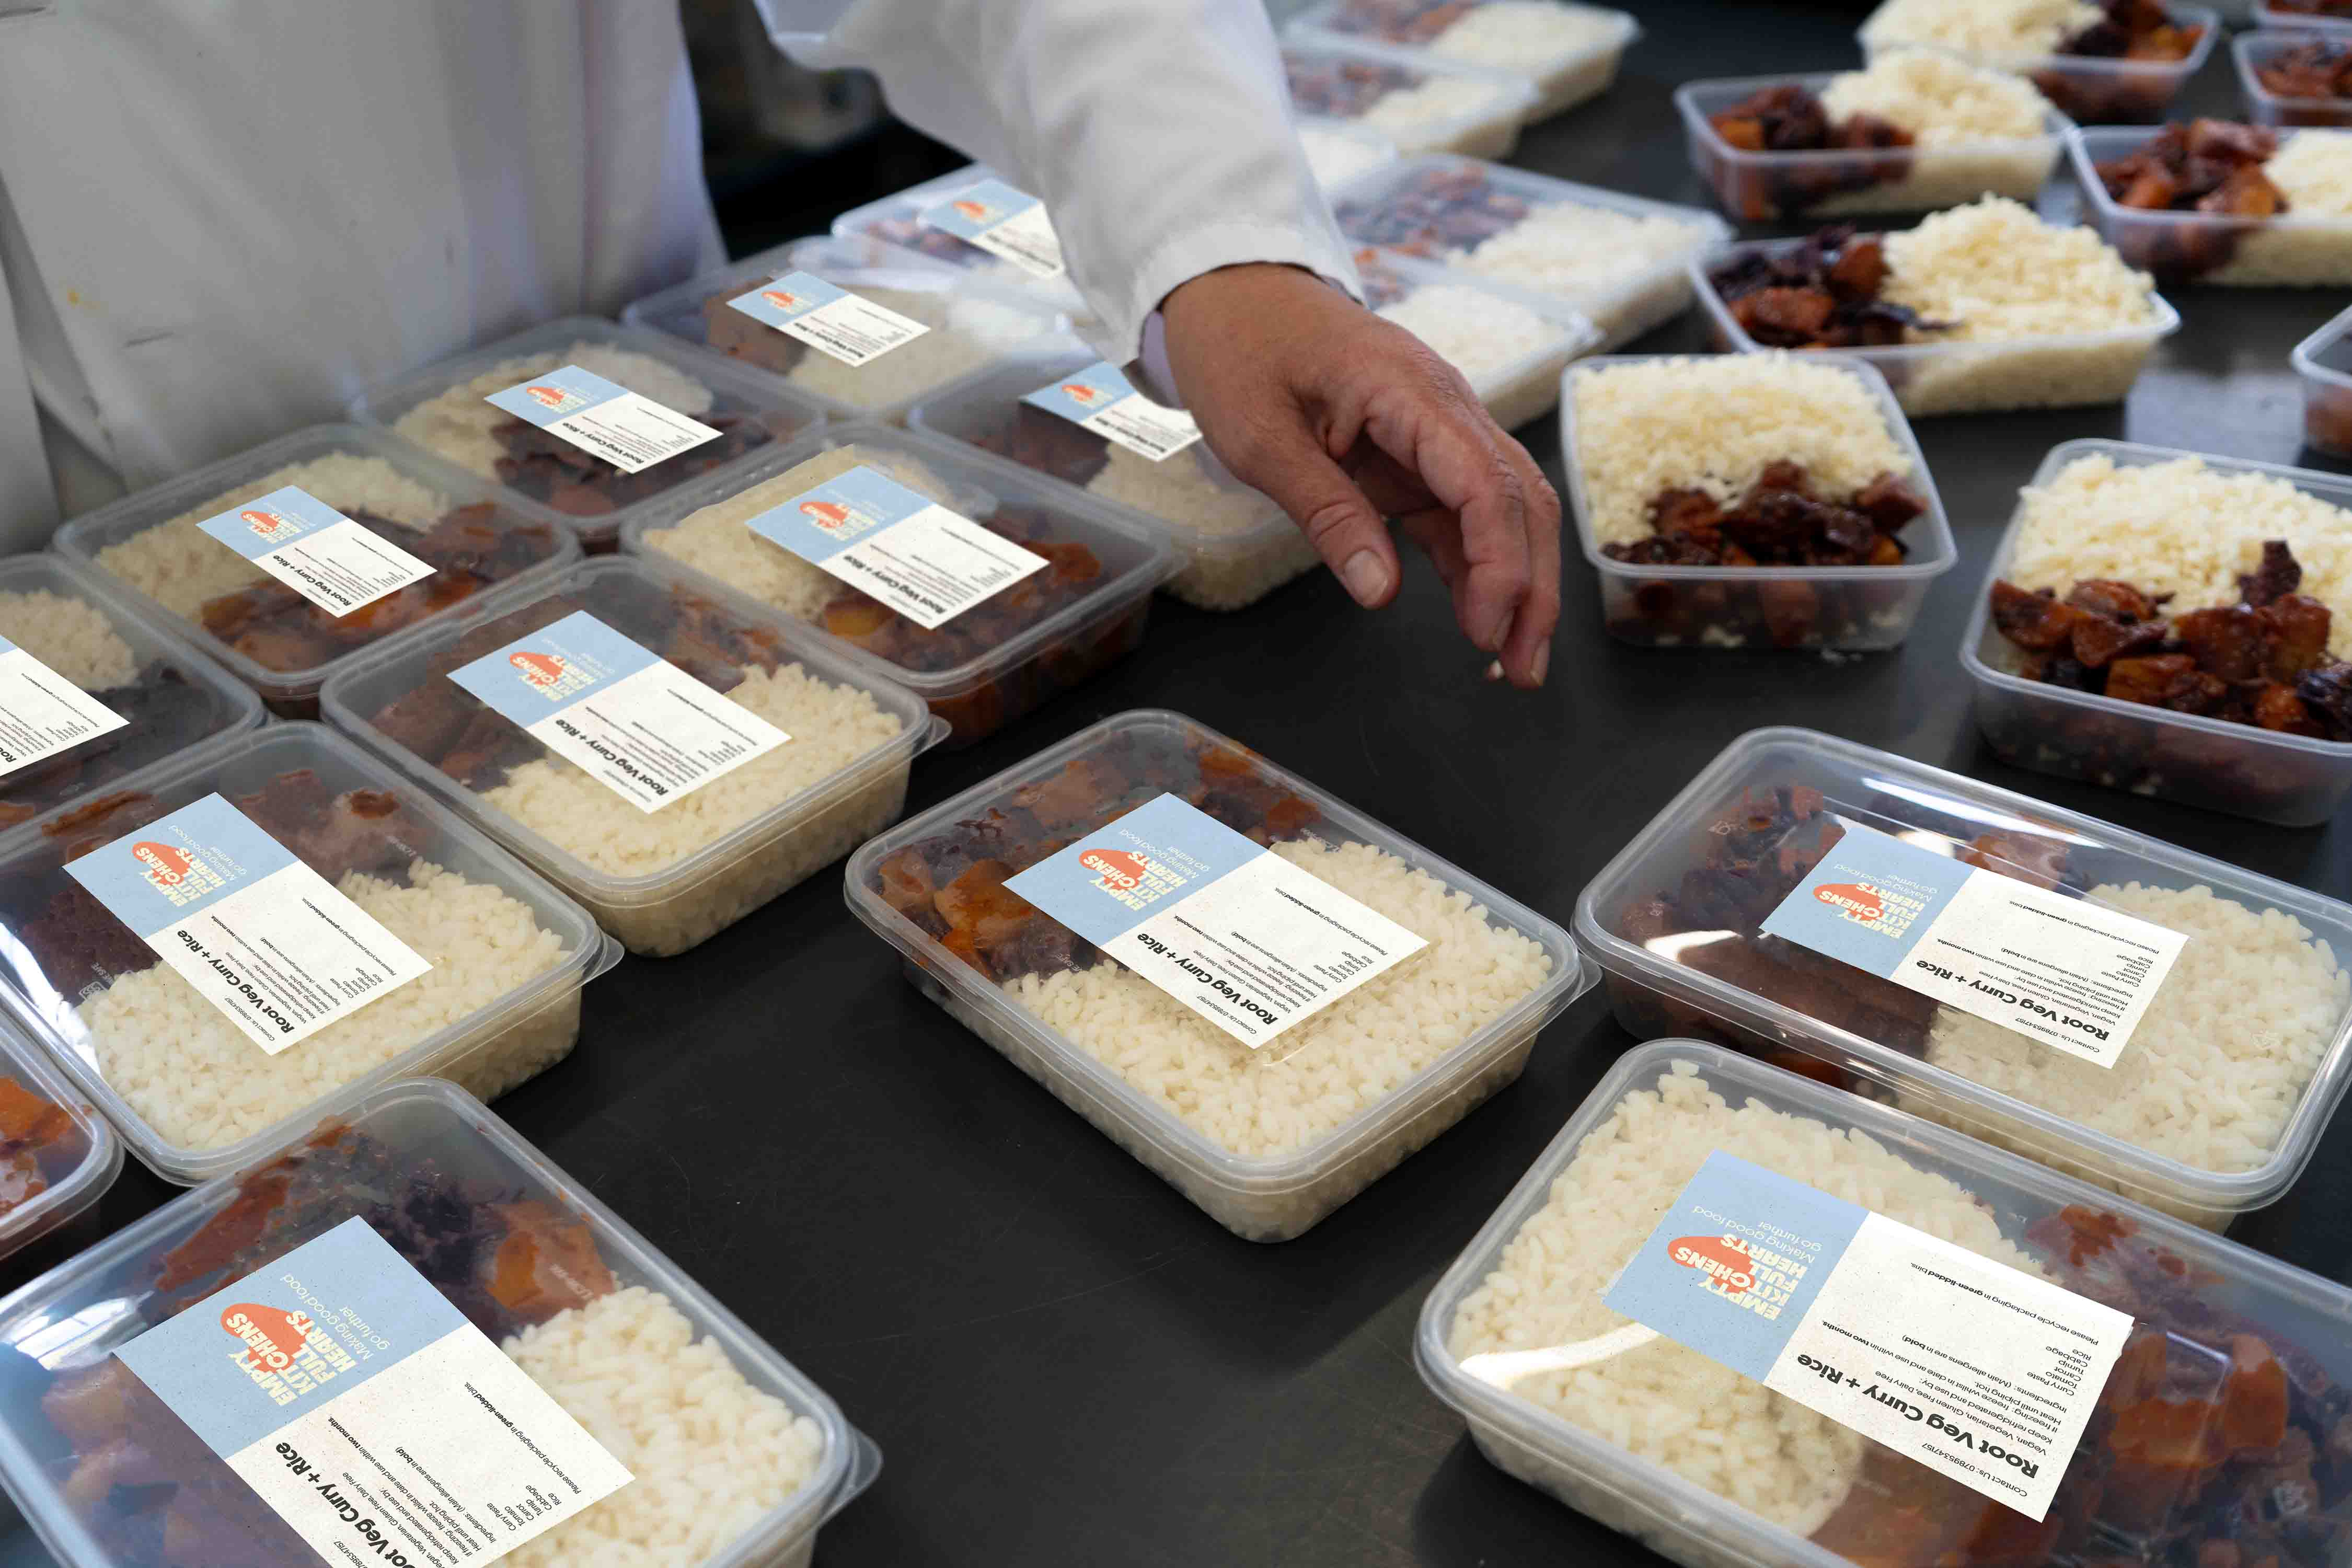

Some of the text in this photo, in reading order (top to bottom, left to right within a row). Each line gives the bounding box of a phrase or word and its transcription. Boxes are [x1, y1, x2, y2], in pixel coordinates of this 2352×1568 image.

[134, 846, 202, 901] KITCHENS
[173, 846, 227, 888] HEARTS
[1081, 853, 1162, 904] KITCHENS
[1125, 849, 1189, 888] HEARTS
[139, 869, 190, 907] EMPTY
[178, 867, 215, 895] FULL
[1088, 875, 1148, 912] EMPTY
[1133, 870, 1175, 896] FULL
[1853, 880, 1927, 912] HEARTS
[1817, 889, 1912, 930] KITCHENS
[1873, 898, 1920, 921] FULL
[1836, 909, 1905, 939] EMPTY
[177, 930, 204, 953] Rice
[1137, 933, 1168, 954] Rice
[207, 959, 240, 986] Curry
[1174, 958, 1213, 983] Curry
[1916, 960, 1953, 980] Rice
[238, 984, 264, 1009] Veg
[1210, 979, 1241, 1004] Veg
[1967, 979, 2017, 1004] Curry
[261, 1006, 295, 1033] Root
[1239, 999, 1278, 1025] Root
[2019, 998, 2057, 1022] Veg
[2061, 1015, 2109, 1041] Root
[1691, 1205, 1816, 1264] Making good food
[1755, 1219, 1824, 1252] go further
[1717, 1231, 1808, 1280] HEARTS
[1672, 1244, 1791, 1308] KITCHENS
[1743, 1259, 1800, 1294] FULL
[1911, 1263, 1928, 1274] bins.
[1928, 1271, 1983, 1295] green-lidded
[1697, 1275, 1782, 1322] EMPTY
[1992, 1296, 2037, 1318] packaging
[279, 1273, 375, 1361] Making good food
[335, 1304, 392, 1351] go further
[1823, 1321, 1852, 1338] months.
[2037, 1316, 2069, 1332] recycle
[282, 1308, 358, 1374] HEARTS
[1853, 1335, 1869, 1345] two
[1870, 1343, 1893, 1357] within
[1902, 1335, 1926, 1350] bold)
[2070, 1330, 2099, 1345] Please
[223, 1310, 319, 1396] KITCHENS
[286, 1342, 339, 1385] FULL
[1895, 1354, 1909, 1364] use
[1934, 1350, 1947, 1358] are
[2045, 1346, 2088, 1367] Cabbage
[2072, 1349, 2091, 1361] Rice
[228, 1347, 299, 1407] EMPTY
[1909, 1362, 1927, 1371] and
[1927, 1369, 1946, 1380] date
[1948, 1356, 1987, 1376] allergens
[2054, 1367, 2081, 1381] Carrot
[2058, 1360, 2083, 1375] Turnip
[464, 1382, 478, 1396] bins.
[1955, 1382, 1979, 1396] whilst
[1987, 1374, 2011, 1388] (Main
[2027, 1372, 2074, 1396] Curry Paste
[2045, 1371, 2077, 1389] Tomato
[474, 1393, 514, 1427] green-lidded
[1919, 1378, 2053, 1444] Keep refridgerated and use by:
[1975, 1381, 2061, 1425] Heat until piping hot.
[1981, 1394, 2009, 1410] freeze
[2014, 1386, 2067, 1413] Ingredients:
[1797, 1354, 2039, 1479] Root Veg Curry + Rice
[1875, 1371, 2046, 1456] Vegan, Vegetarian, Gluten Free, Dairy Free
[2012, 1408, 2051, 1429] freezing:
[515, 1431, 546, 1458] packaging
[1921, 1443, 1975, 1471] 07895347157
[275, 1442, 312, 1475] Rice
[543, 1458, 564, 1477] recycle
[307, 1473, 320, 1483] +
[562, 1477, 581, 1494] Please
[1991, 1475, 2027, 1496] Contact
[315, 1483, 359, 1522] Curry
[354, 1518, 389, 1554] Veg
